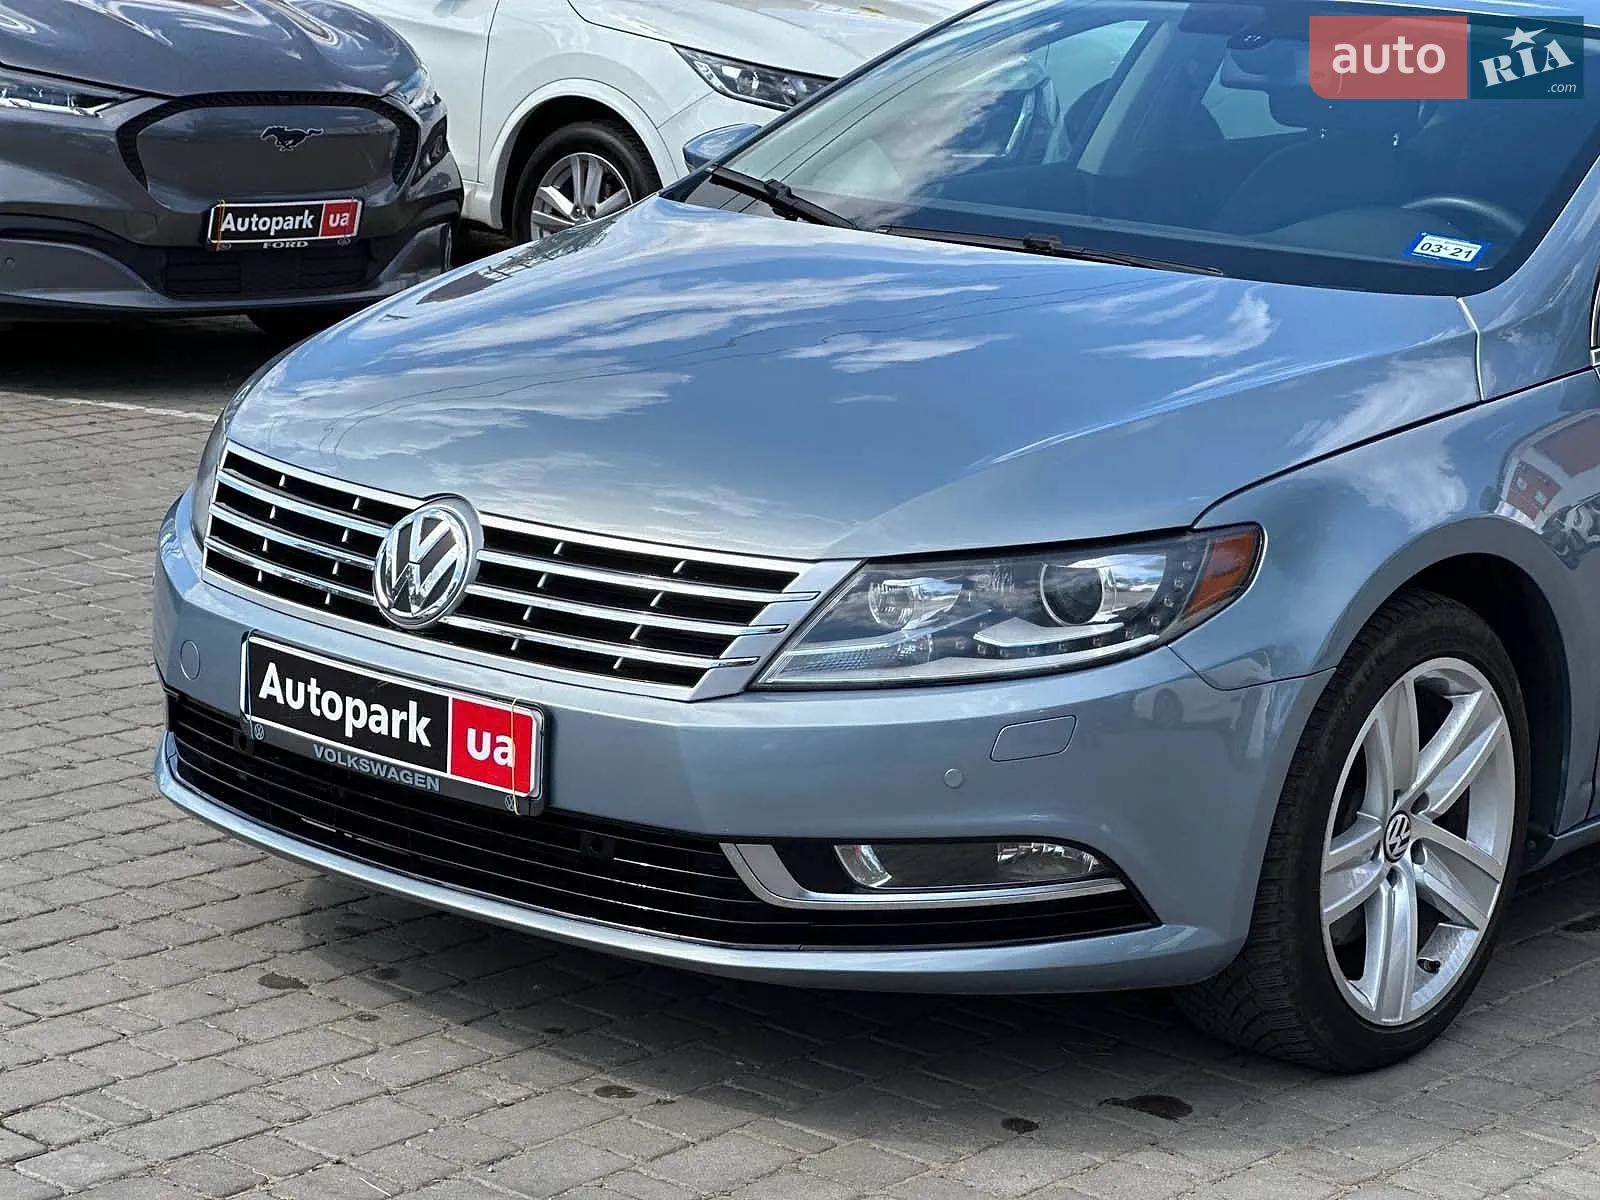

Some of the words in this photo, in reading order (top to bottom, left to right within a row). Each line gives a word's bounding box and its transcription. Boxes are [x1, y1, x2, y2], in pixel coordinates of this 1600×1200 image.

[221, 209, 315, 236] Autopark
[328, 212, 350, 228] ua
[263, 240, 309, 249] FORD
[258, 662, 432, 748] Autopark
[466, 727, 515, 768] ua
[313, 743, 441, 792] VOLKSWAGEN
